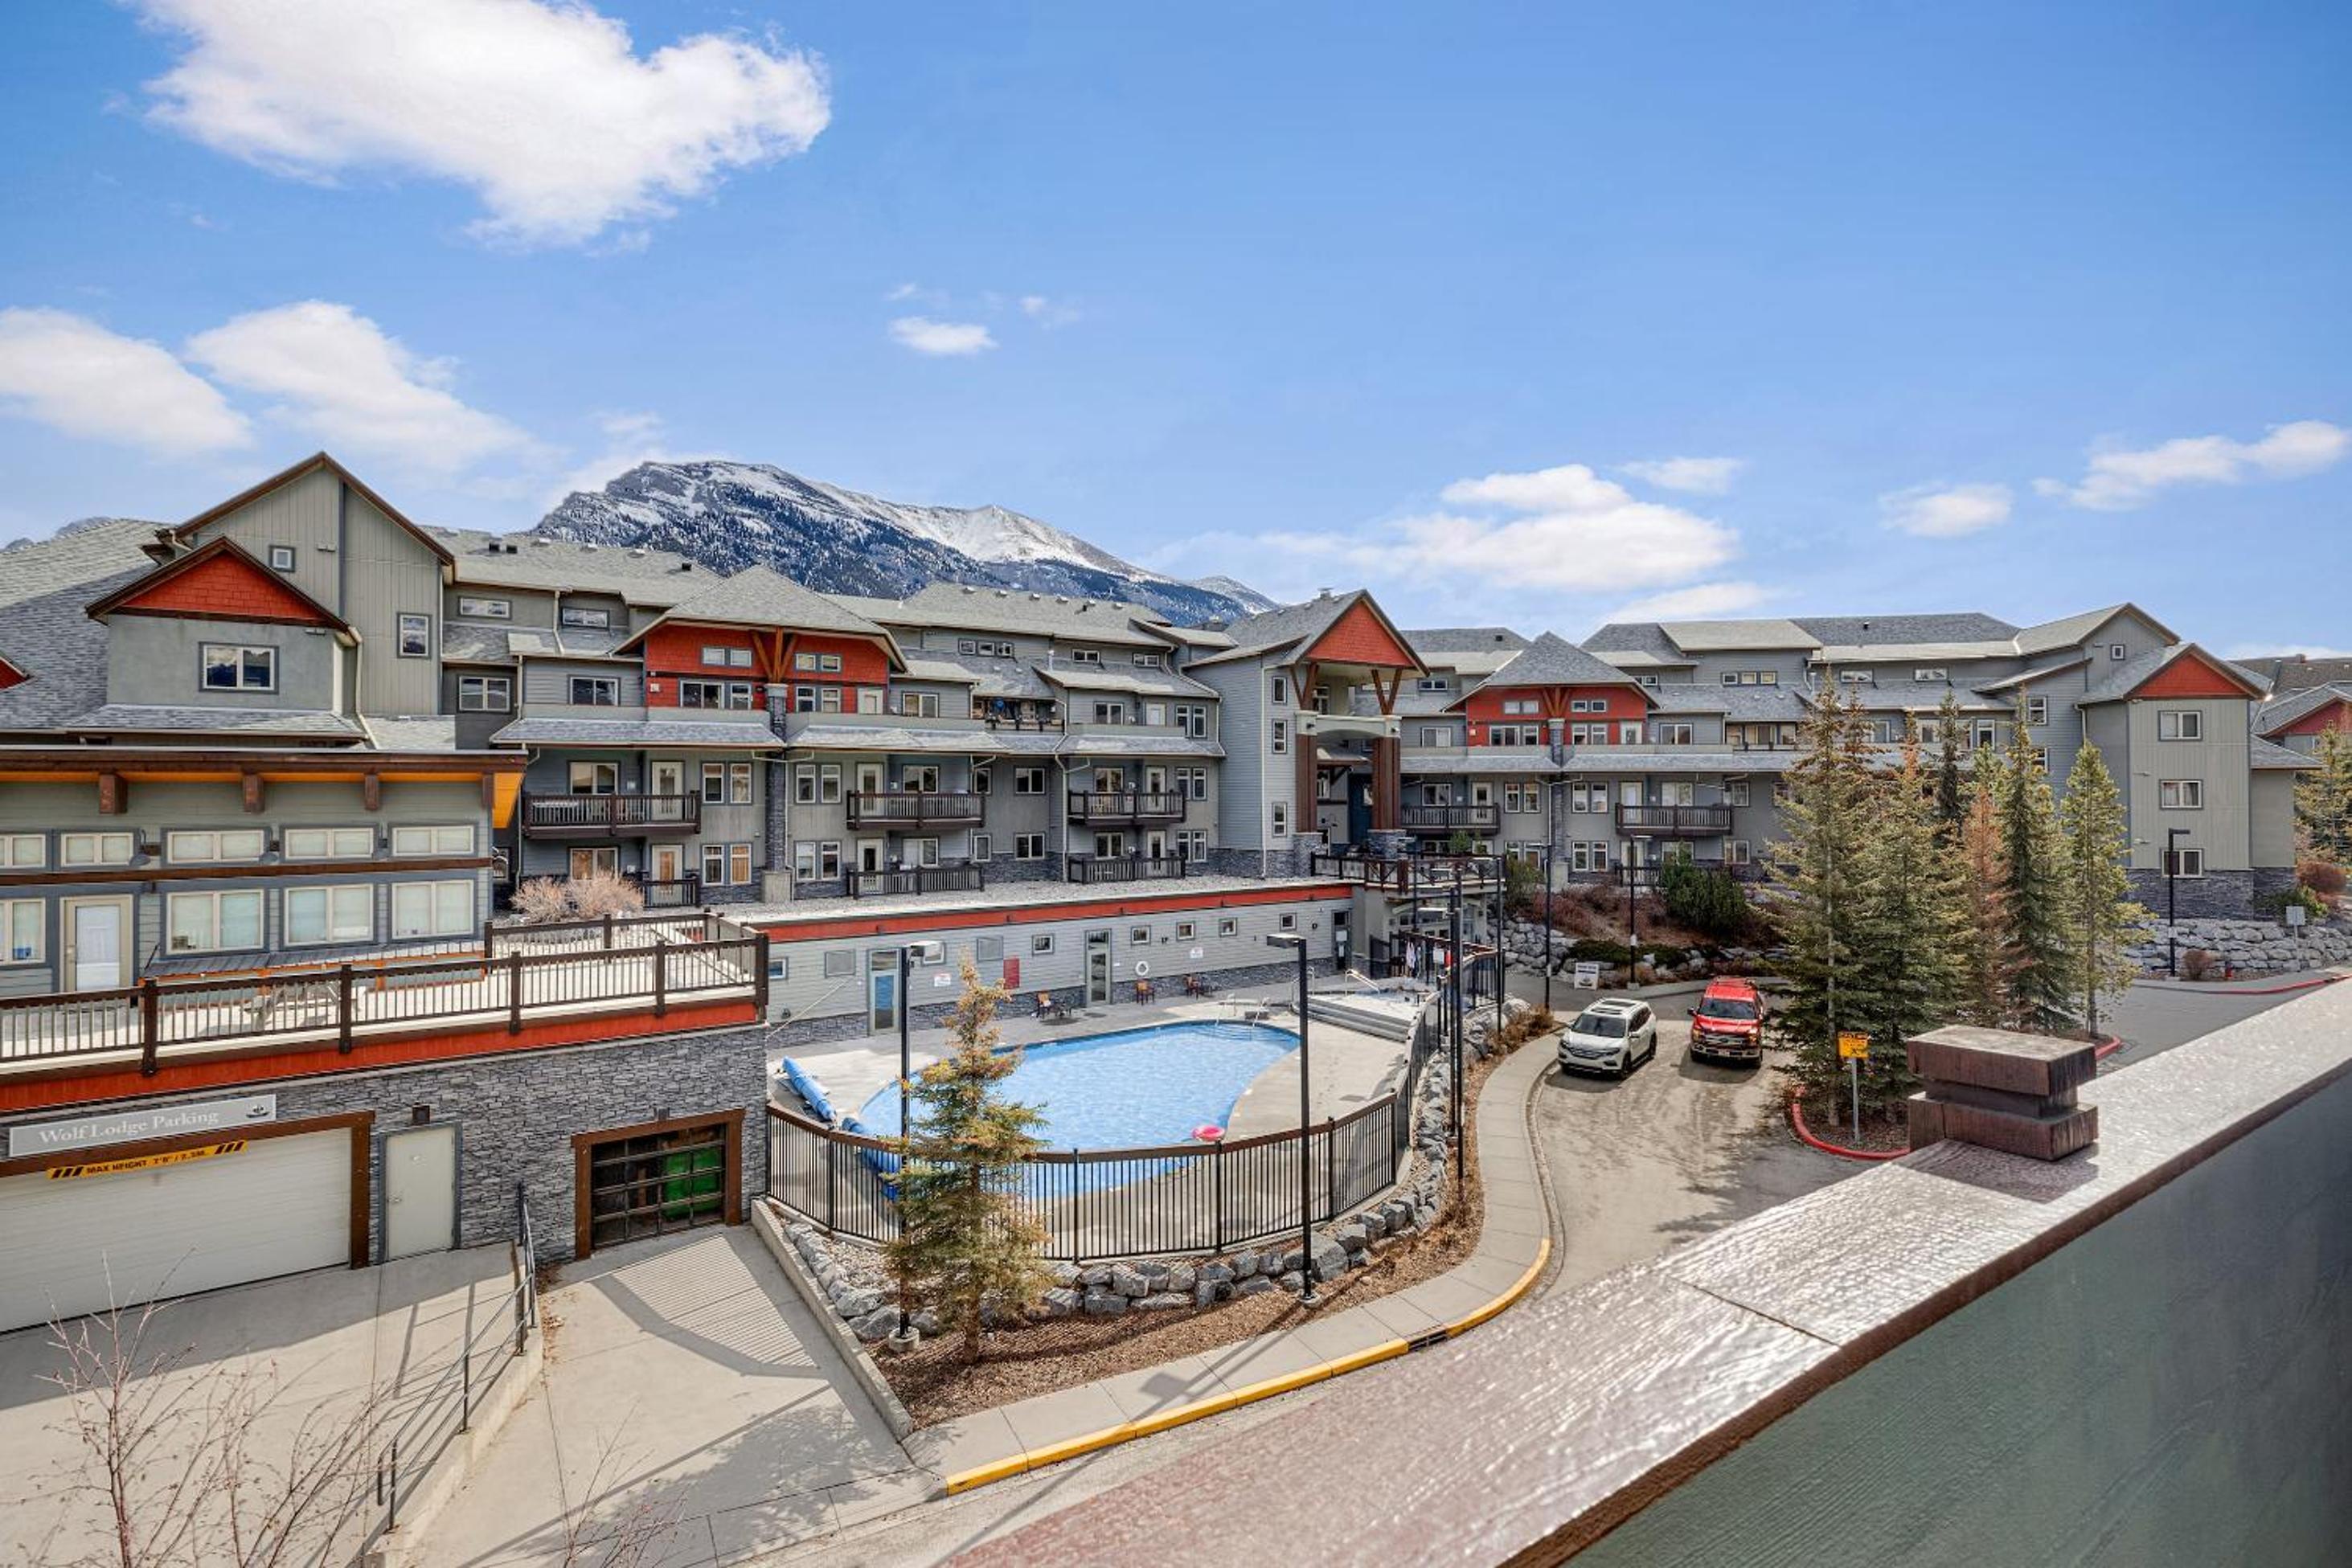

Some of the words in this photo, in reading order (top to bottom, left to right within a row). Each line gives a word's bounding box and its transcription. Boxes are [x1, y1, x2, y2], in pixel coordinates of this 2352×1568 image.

[39, 1124, 89, 1143] Wolf
[90, 1121, 149, 1138] Lodge
[152, 1112, 219, 1129] Parking
[113, 1160, 147, 1170] HEIGHT
